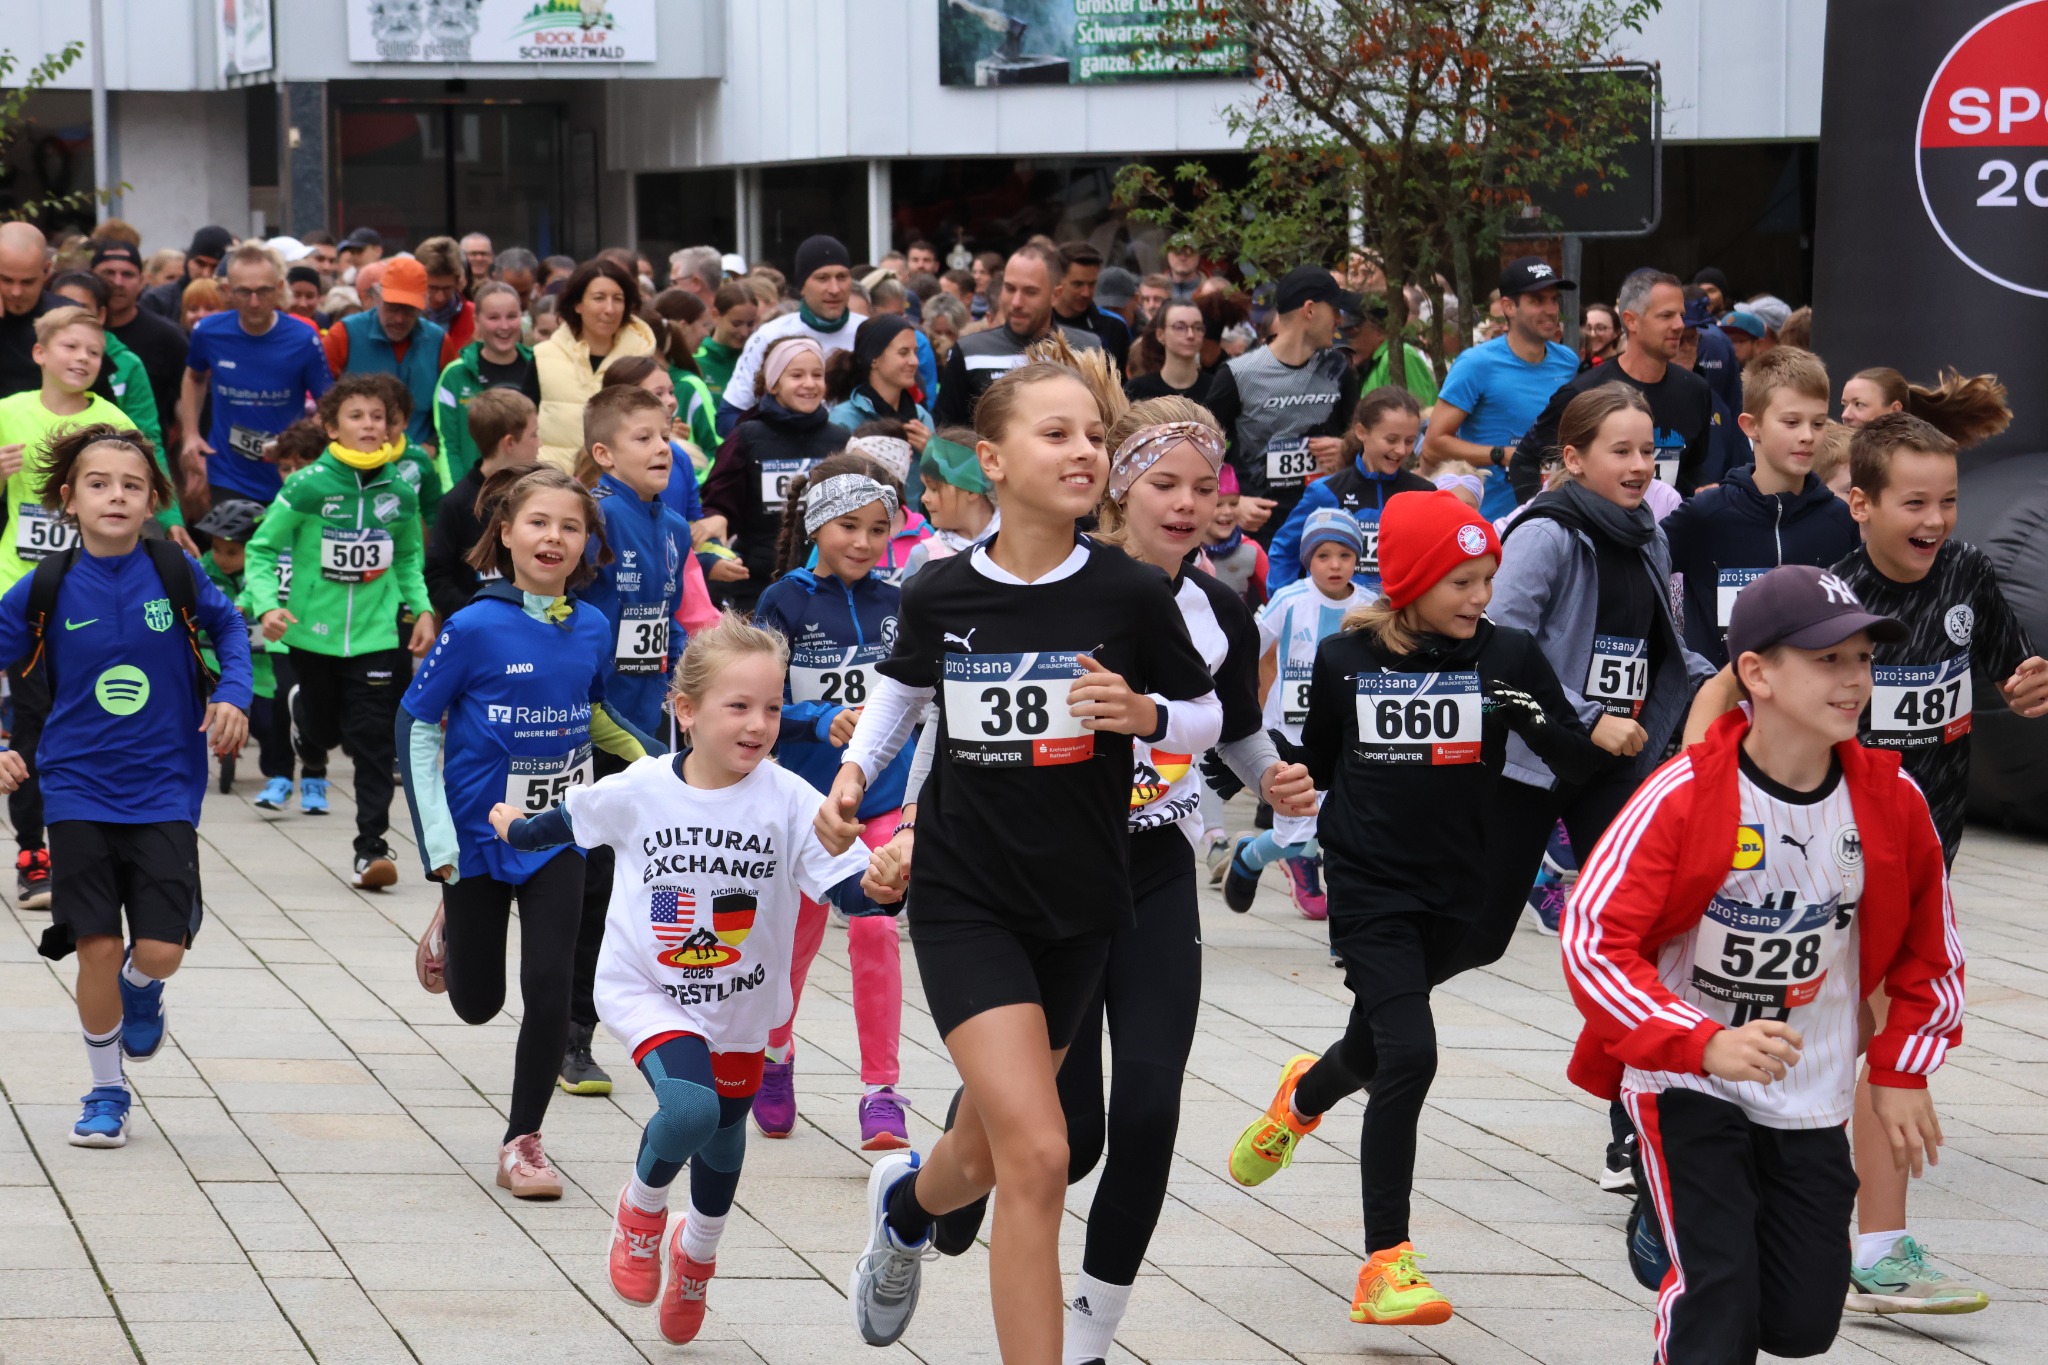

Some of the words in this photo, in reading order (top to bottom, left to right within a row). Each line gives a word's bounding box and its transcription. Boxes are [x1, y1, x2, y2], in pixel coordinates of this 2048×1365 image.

[534, 32, 575, 45] BOCK
[581, 32, 607, 45] AUF
[519, 46, 625, 60] SCHWARZWALD
[1948, 86, 2048, 135] SP
[1263, 393, 1341, 409] DYNAFIT
[1279, 452, 1318, 475] 833
[30, 520, 80, 549] 507
[333, 544, 380, 568] 503
[311, 622, 328, 635] 49
[802, 632, 826, 640] erima
[1050, 655, 1058, 663] 5.
[505, 663, 534, 674] JAKO
[1598, 658, 1645, 696] 514
[820, 669, 866, 705] 28
[980, 685, 1050, 737] 38
[1606, 705, 1631, 714] WALTER
[1894, 679, 1962, 727] 487
[516, 706, 568, 724] Raiba
[1375, 698, 1460, 740] 660
[514, 730, 545, 738] UNSERE
[1877, 738, 1906, 746] SPORT
[1907, 736, 1938, 746] WALTER
[957, 750, 981, 761] SPORT
[982, 751, 1022, 762] WALTER
[1364, 752, 1389, 761] SPORT
[1389, 753, 1423, 761] WALTER
[643, 827, 775, 857] CULTURAL
[643, 855, 777, 884] EXCHANGE
[651, 884, 696, 896] MONTANA
[1721, 932, 1821, 980] 528
[683, 966, 714, 979] 2026
[1700, 978, 1731, 993] SPORT
[1732, 990, 1774, 1003] WALTER
